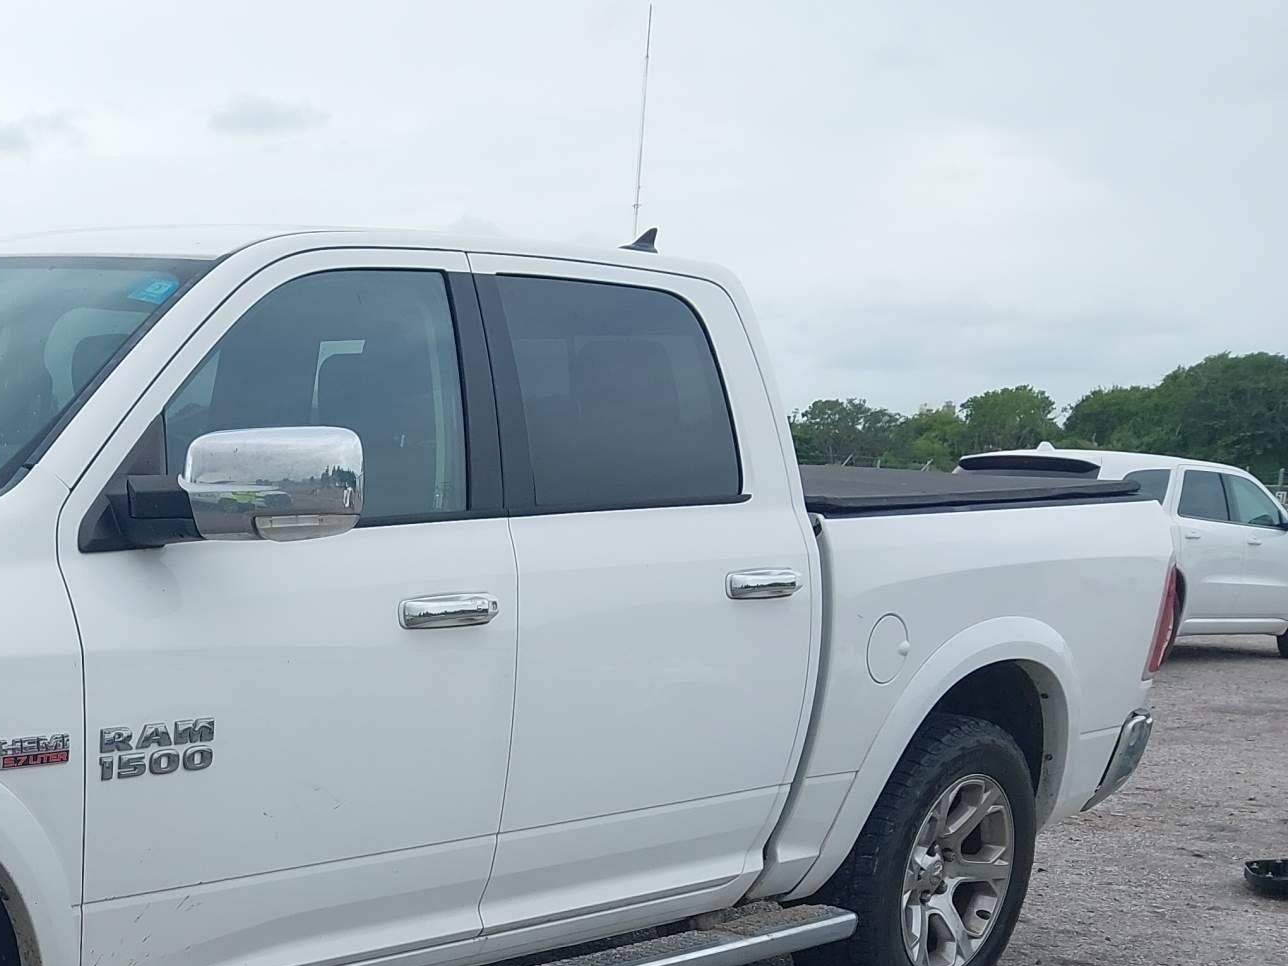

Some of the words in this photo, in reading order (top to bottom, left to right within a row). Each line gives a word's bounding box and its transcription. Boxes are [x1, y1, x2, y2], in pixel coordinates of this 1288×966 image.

[99, 717, 215, 754] RAM
[28, 751, 68, 765] LITER
[98, 745, 214, 781] 1500
